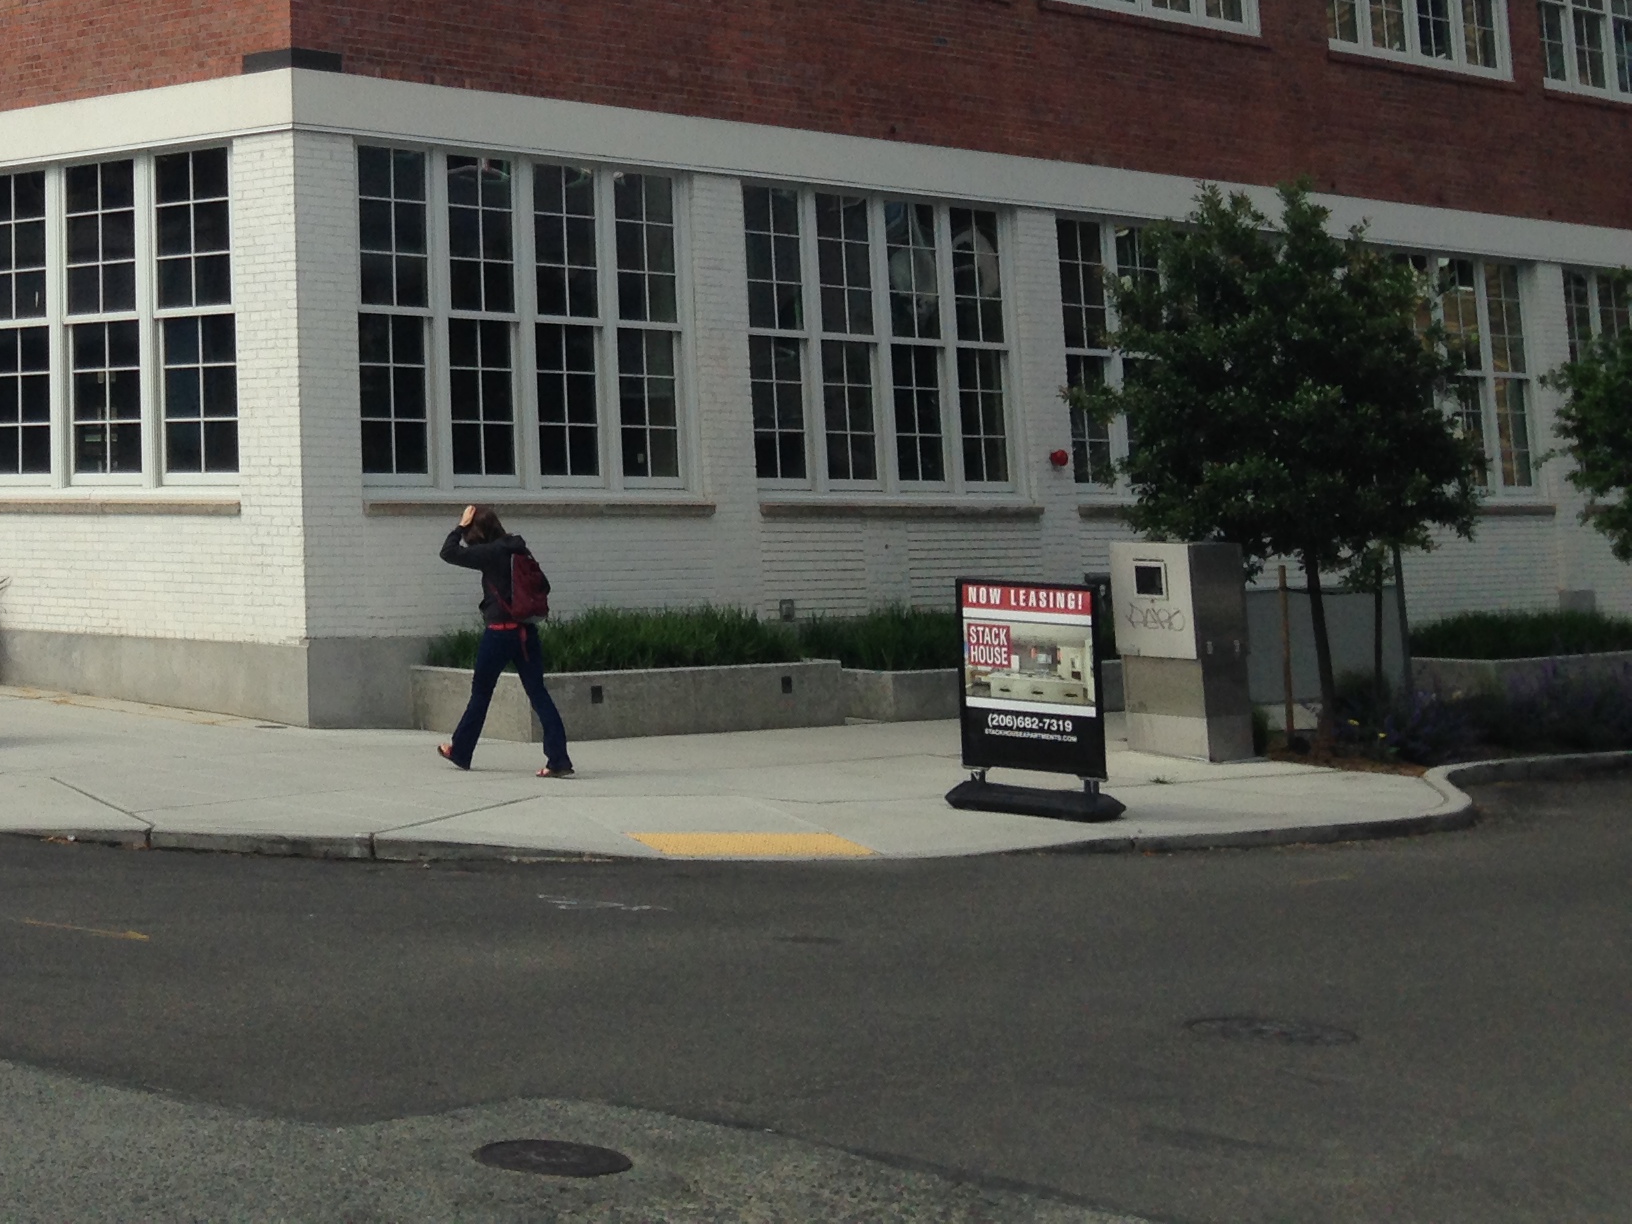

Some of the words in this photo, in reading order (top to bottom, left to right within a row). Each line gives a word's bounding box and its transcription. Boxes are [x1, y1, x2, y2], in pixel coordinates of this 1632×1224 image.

[968, 586, 1001, 605] NOW
[1010, 588, 1083, 610] LEASING!
[969, 625, 1007, 645] STACK
[970, 645, 1008, 665] HOUSE
[988, 713, 1073, 732] (206)682-7319
